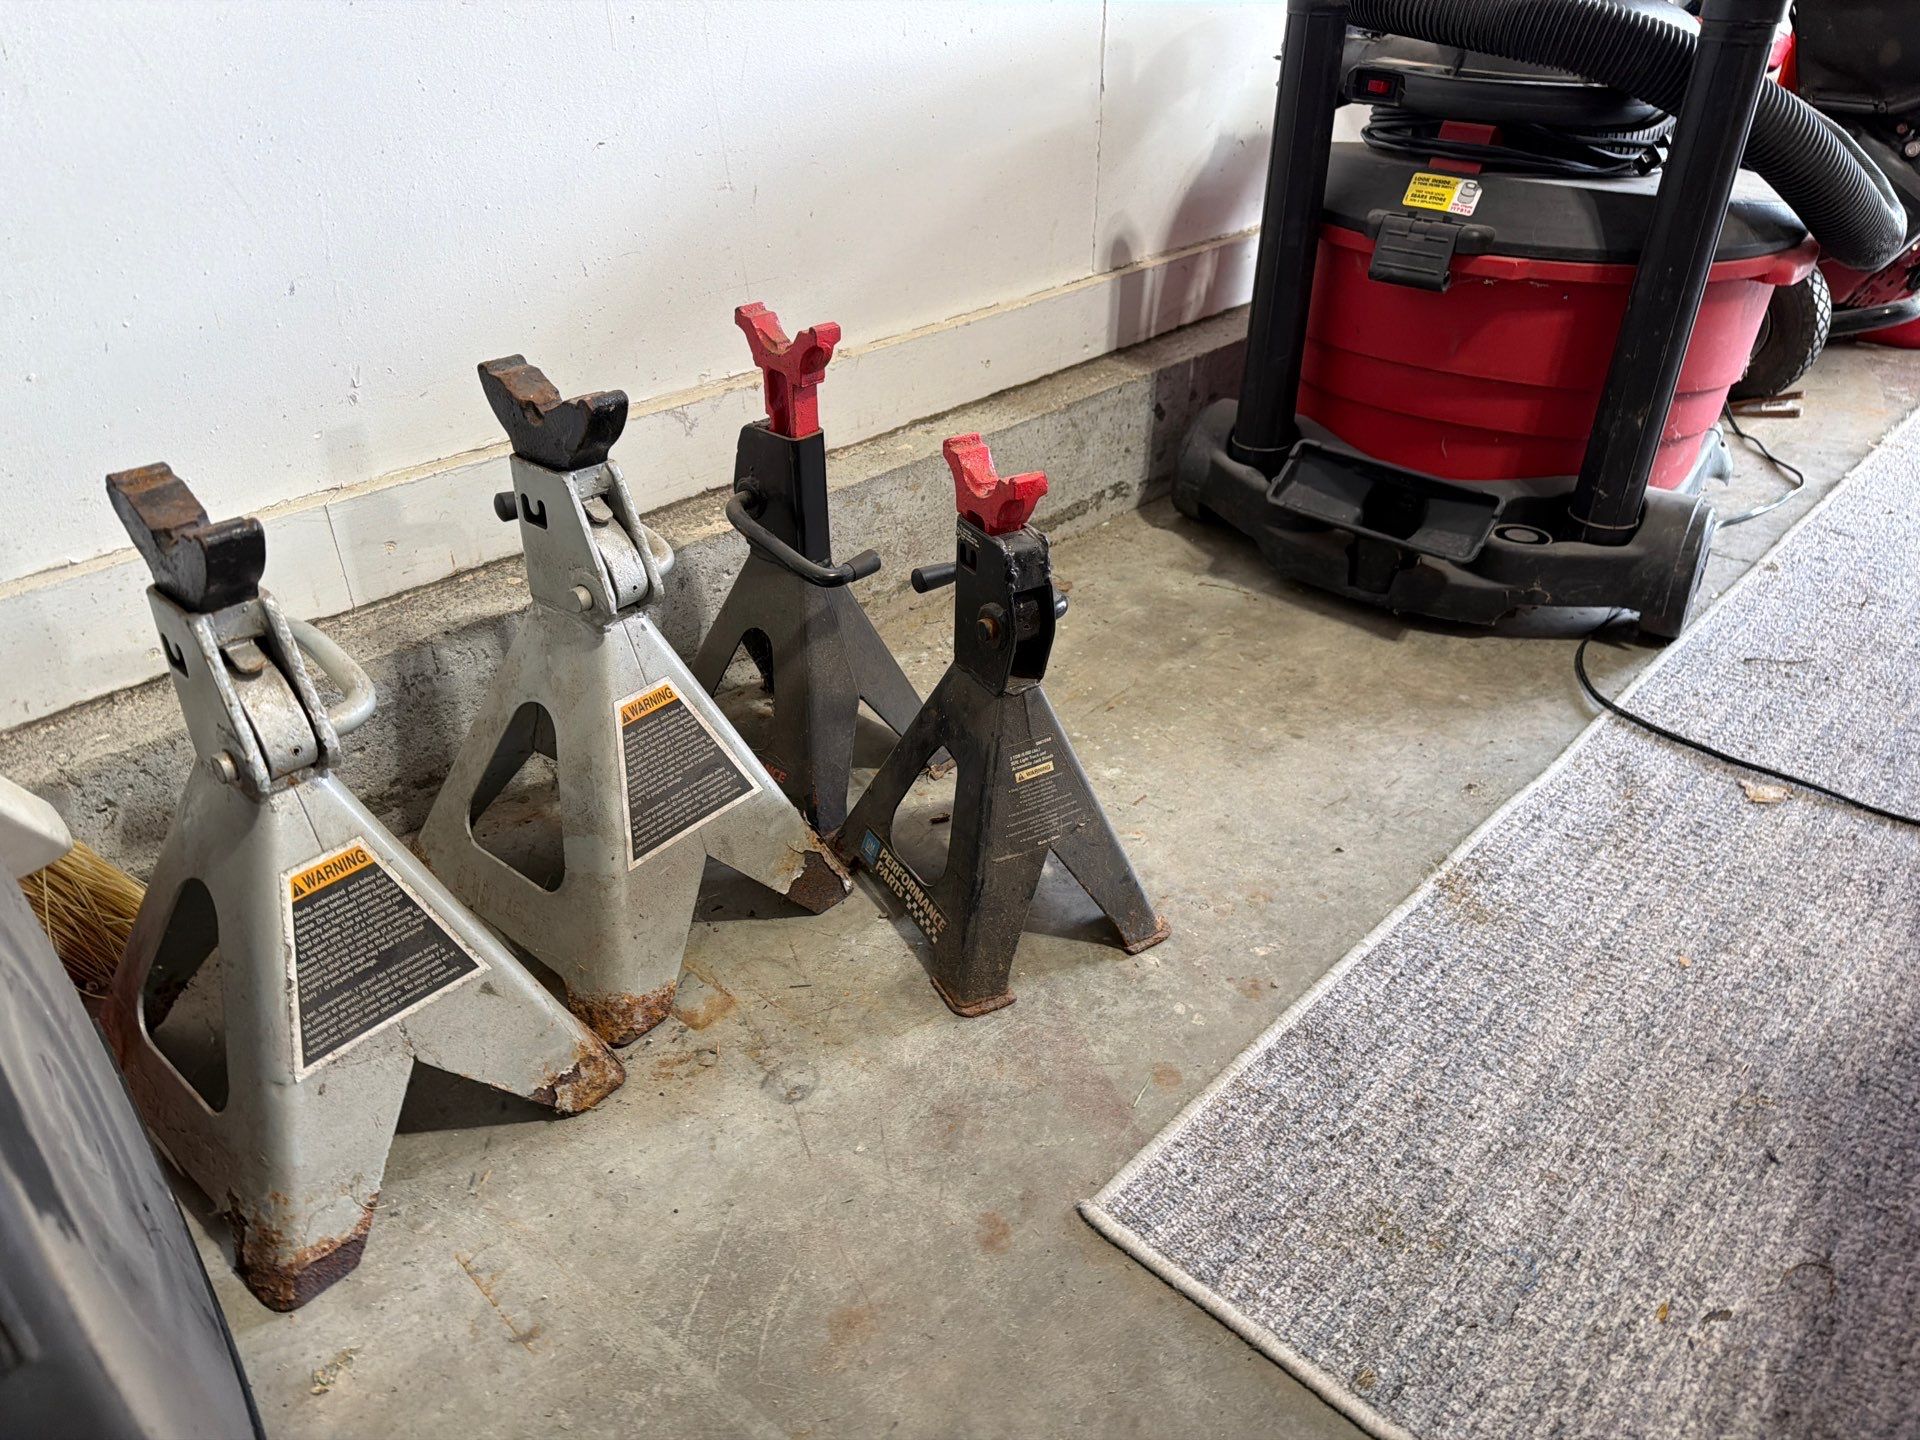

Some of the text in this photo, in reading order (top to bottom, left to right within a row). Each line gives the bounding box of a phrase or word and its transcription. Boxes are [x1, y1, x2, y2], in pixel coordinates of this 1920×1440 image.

[629, 688, 673, 717] WARNING
[1025, 763, 1050, 778] WARNING
[301, 849, 368, 889] WARNING
[311, 888, 346, 909] understand
[346, 882, 359, 892] and
[358, 874, 376, 886] follow
[375, 870, 384, 878] all
[875, 860, 905, 898] PARTS
[878, 847, 947, 933] PERFORMANCE
[294, 877, 387, 926] instructions before operating this
[296, 932, 309, 942] Use
[308, 925, 323, 937] only
[322, 922, 331, 930] on
[330, 914, 345, 925] hard
[344, 907, 359, 918] level
[380, 887, 401, 900] Center
[297, 939, 312, 950] load
[340, 918, 354, 928] Use
[366, 899, 392, 915] matched
[391, 893, 404, 904] pair
[314, 915, 326, 925] Do
[325, 910, 336, 919] not
[335, 900, 357, 914] exceed
[356, 892, 372, 904] rated
[295, 955, 317, 969] Stands
[316, 950, 327, 959] are
[326, 944, 337, 953] not
[343, 936, 352, 945] be
[351, 929, 367, 940] used
[366, 925, 374, 933] to
[297, 961, 321, 978] support
[319, 954, 334, 965] both
[333, 946, 348, 958] ends
[355, 937, 368, 947] one
[367, 930, 380, 940] side
[412, 909, 422, 917] No
[298, 951, 306, 959] to
[305, 939, 330, 956] support
[329, 934, 341, 943] one
[340, 927, 354, 937] end
[352, 923, 361, 931] of
[365, 910, 386, 925] vehicle
[326, 959, 342, 970] shall
[340, 954, 350, 963] be
[349, 945, 367, 958] made
[366, 941, 374, 949] to
[373, 936, 385, 946] this
[407, 914, 427, 928] Failure
[300, 985, 307, 993] to
[322, 968, 340, 981] these
[339, 955, 366, 973] markings
[365, 949, 379, 960] may
[377, 939, 394, 952] result
[400, 924, 425, 941] personal
[322, 983, 331, 991] or
[329, 970, 354, 987] property
